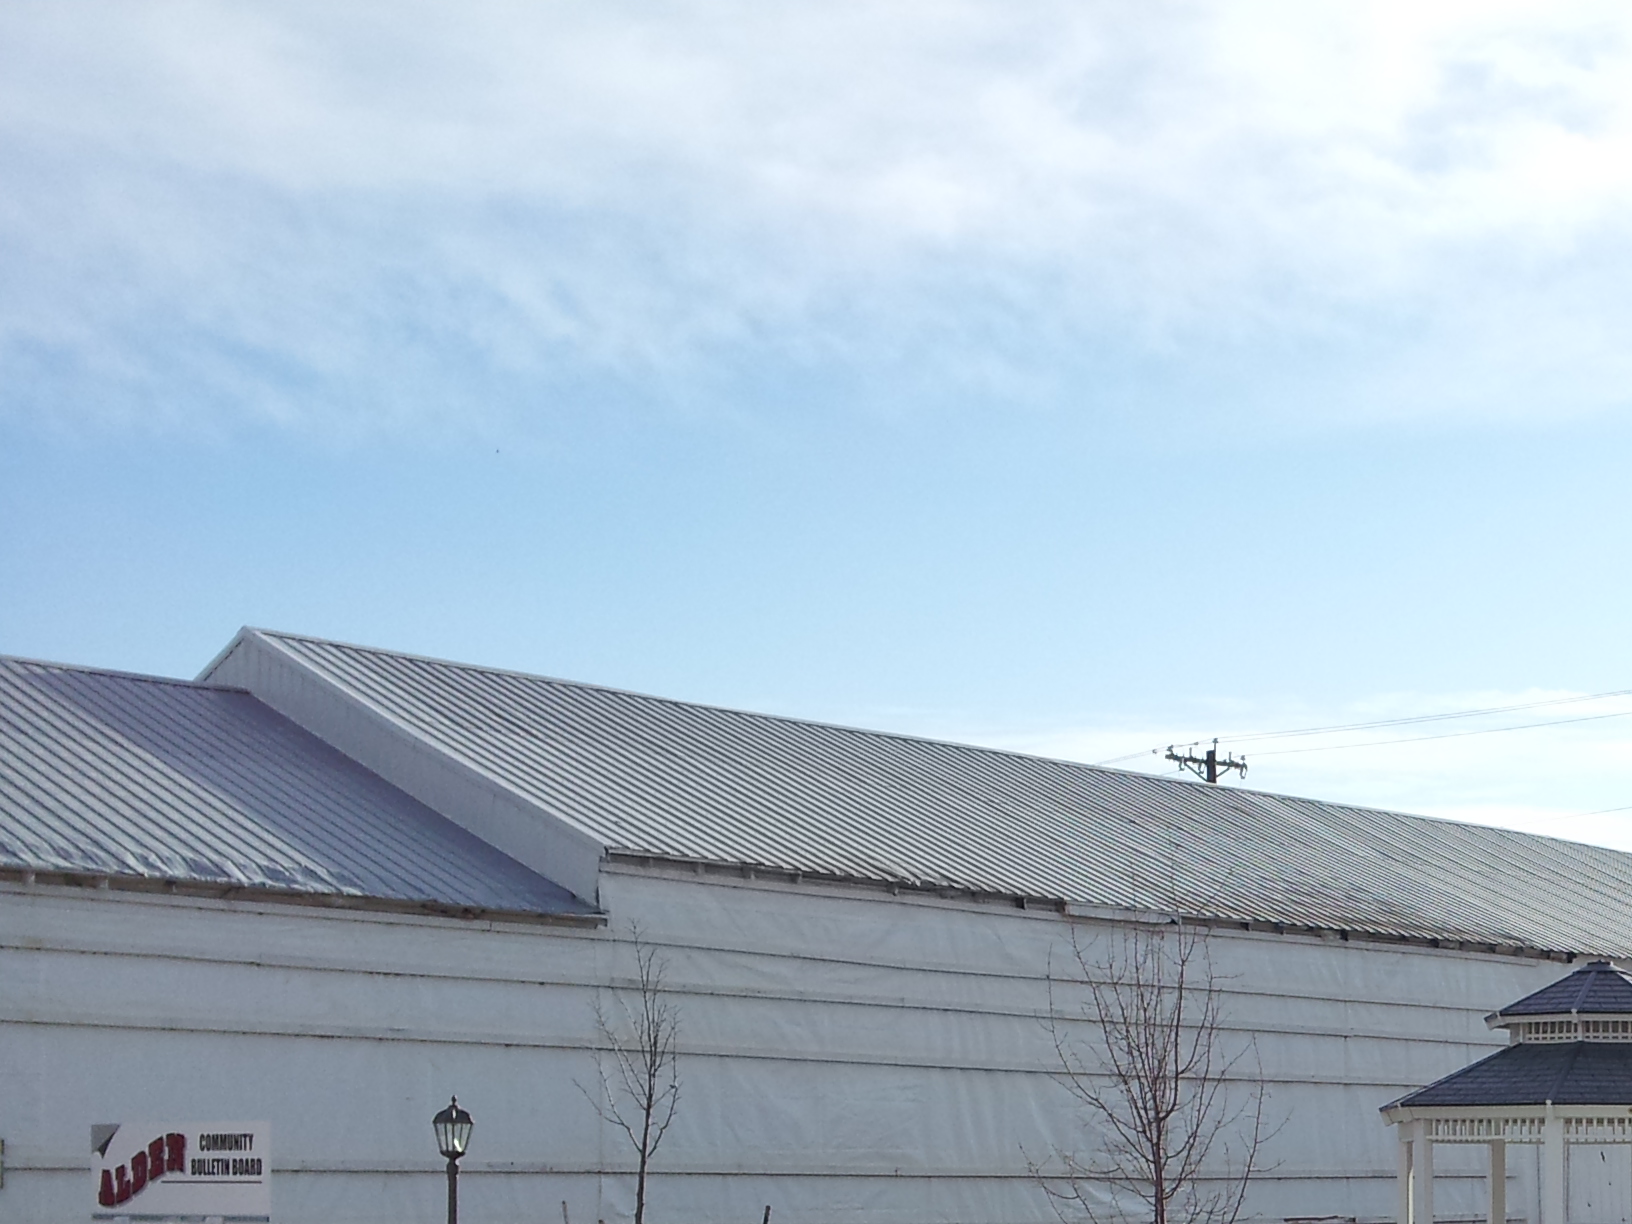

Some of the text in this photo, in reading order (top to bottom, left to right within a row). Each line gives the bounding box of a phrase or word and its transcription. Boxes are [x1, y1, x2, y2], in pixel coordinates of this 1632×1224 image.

[199, 1133, 254, 1152] COMMUNITY
[98, 1132, 187, 1206] ALDEN
[191, 1158, 263, 1176] BULLETIN BOARD
